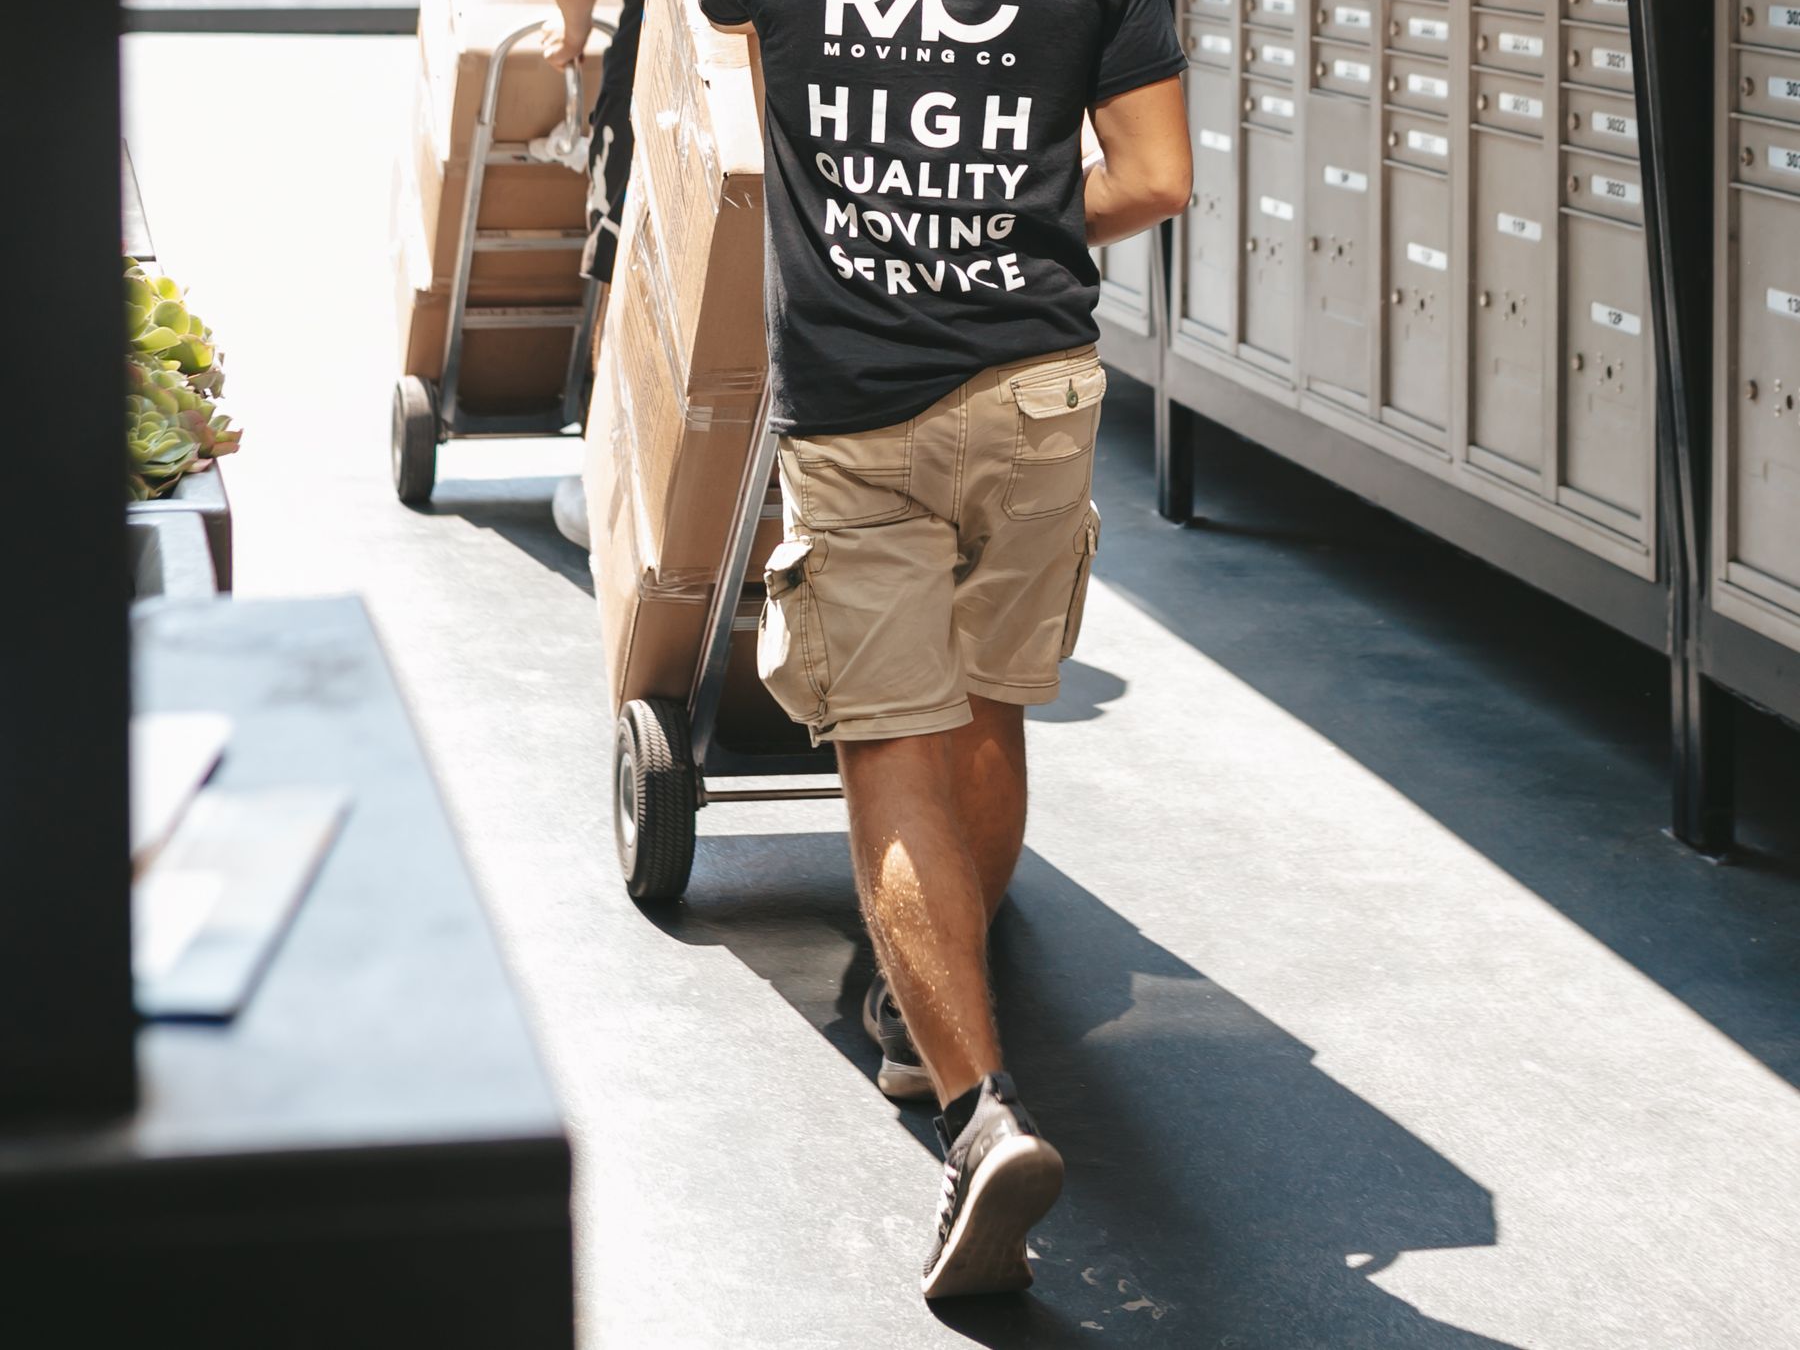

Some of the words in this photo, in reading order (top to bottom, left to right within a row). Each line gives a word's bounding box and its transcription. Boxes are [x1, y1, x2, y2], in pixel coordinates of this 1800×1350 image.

[824, 42, 956, 63] MOVING
[976, 51, 1017, 67] CO
[1606, 52, 1626, 69] 3021
[807, 83, 1033, 150] HIGH
[1606, 117, 1626, 134] 3022
[815, 152, 1029, 200] QUALITY
[1606, 180, 1626, 197] 3023
[824, 198, 1017, 249] MOVING
[829, 244, 1026, 295] SERVICE
